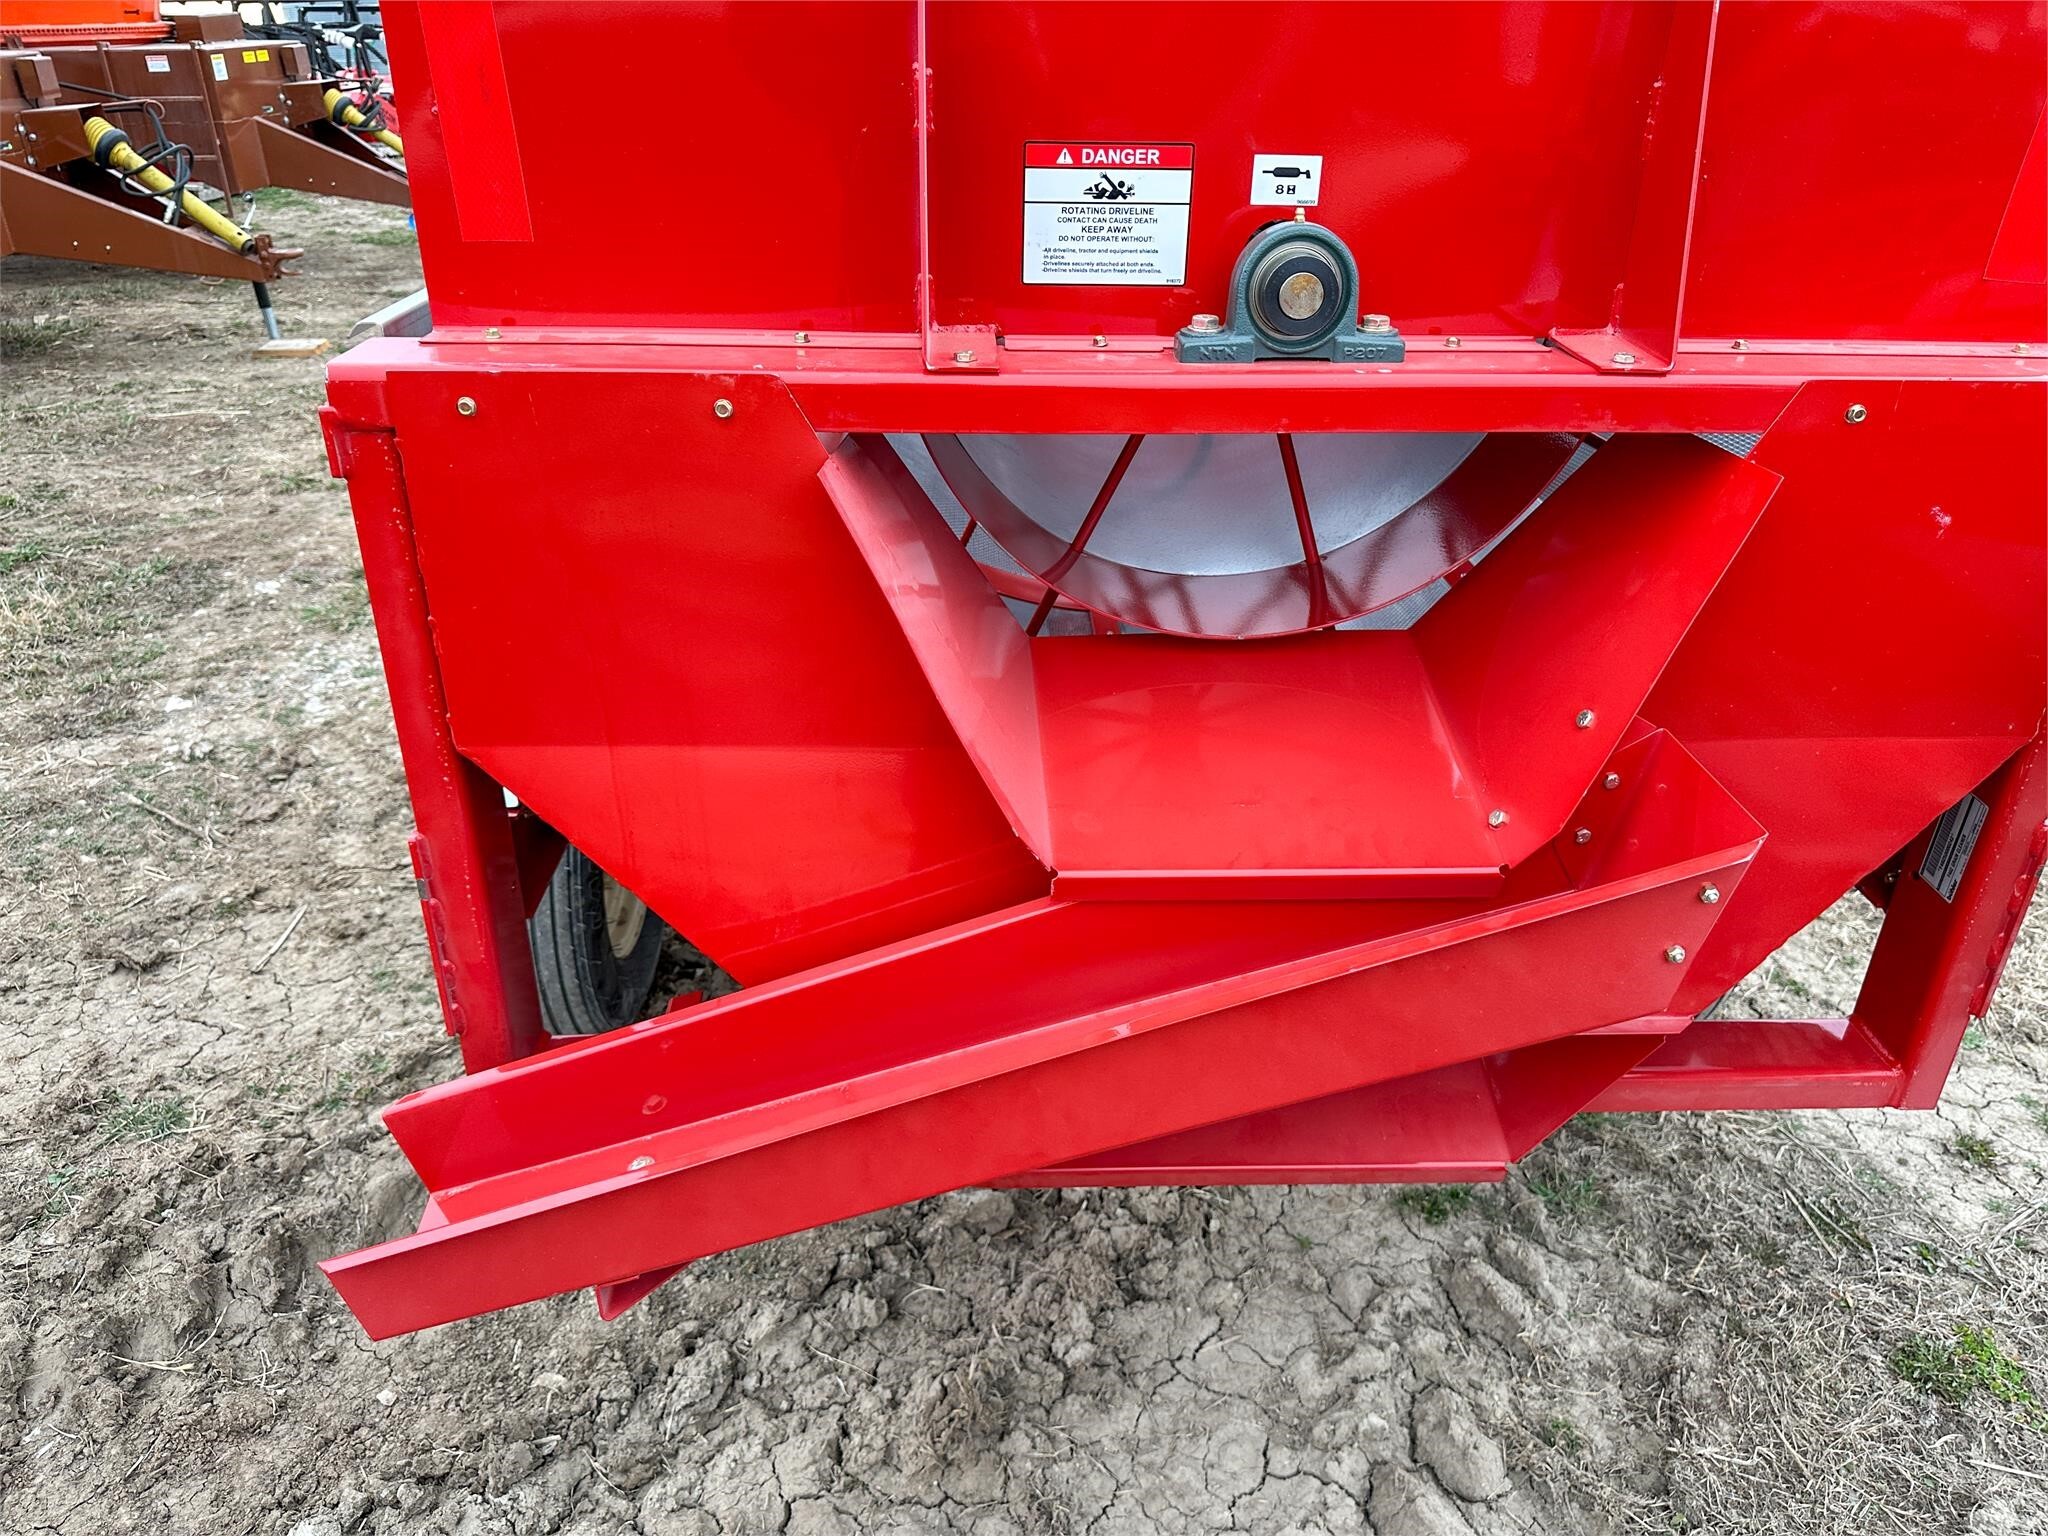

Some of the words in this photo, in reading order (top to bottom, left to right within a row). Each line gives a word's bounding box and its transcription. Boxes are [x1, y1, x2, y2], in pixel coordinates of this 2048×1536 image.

[1081, 148, 1160, 164] DANGER
[1275, 184, 1284, 194] 8
[1108, 207, 1154, 215] DRIVELINE
[1199, 346, 1237, 360] NTN
[1343, 346, 1387, 360] P207
